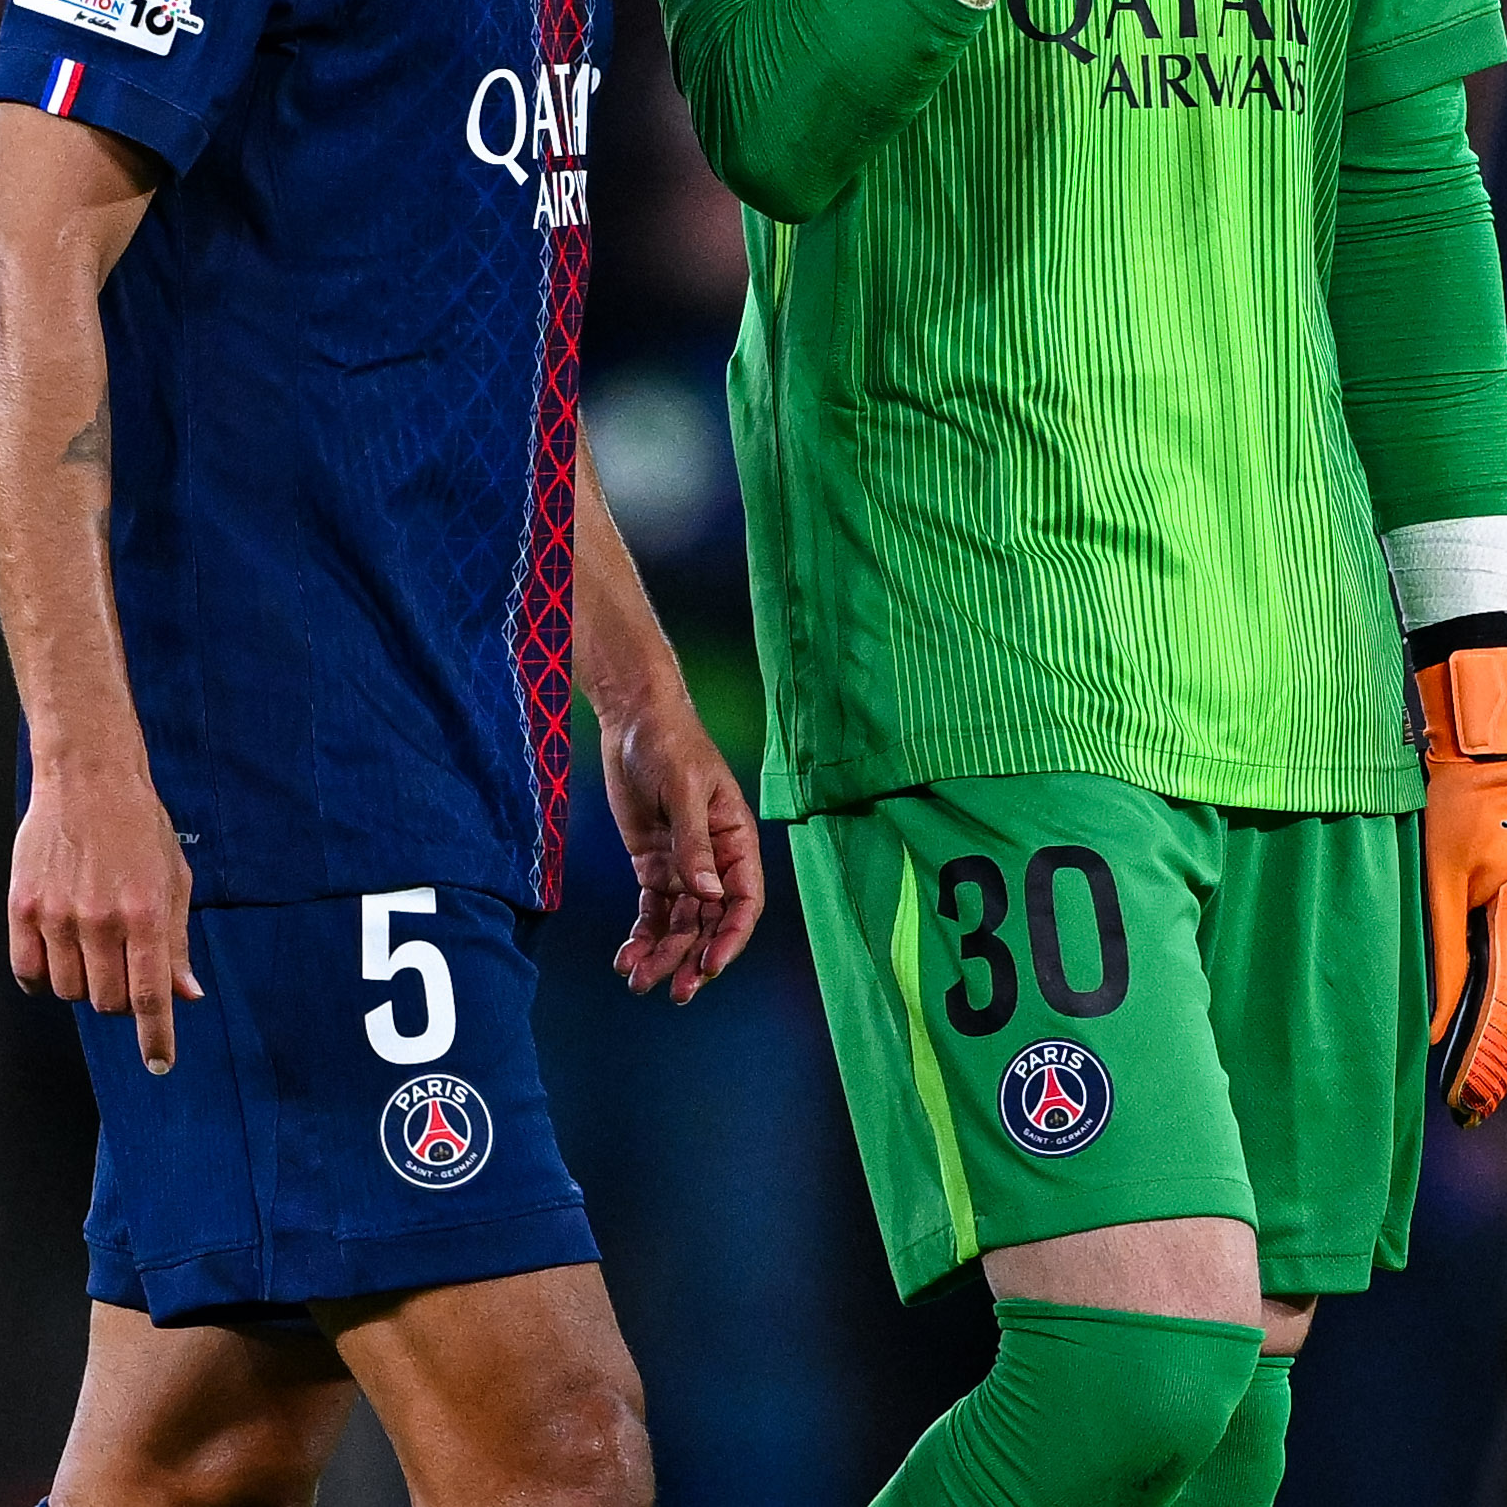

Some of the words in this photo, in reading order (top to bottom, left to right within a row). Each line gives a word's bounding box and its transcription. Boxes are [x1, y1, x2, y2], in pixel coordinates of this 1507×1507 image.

[1099, 53, 1306, 116] AIRWAYS
[936, 843, 1131, 1038] 30
[361, 887, 456, 1065] 5
[1014, 1046, 1085, 1079] PARIS
[395, 1079, 469, 1111] PARIS
